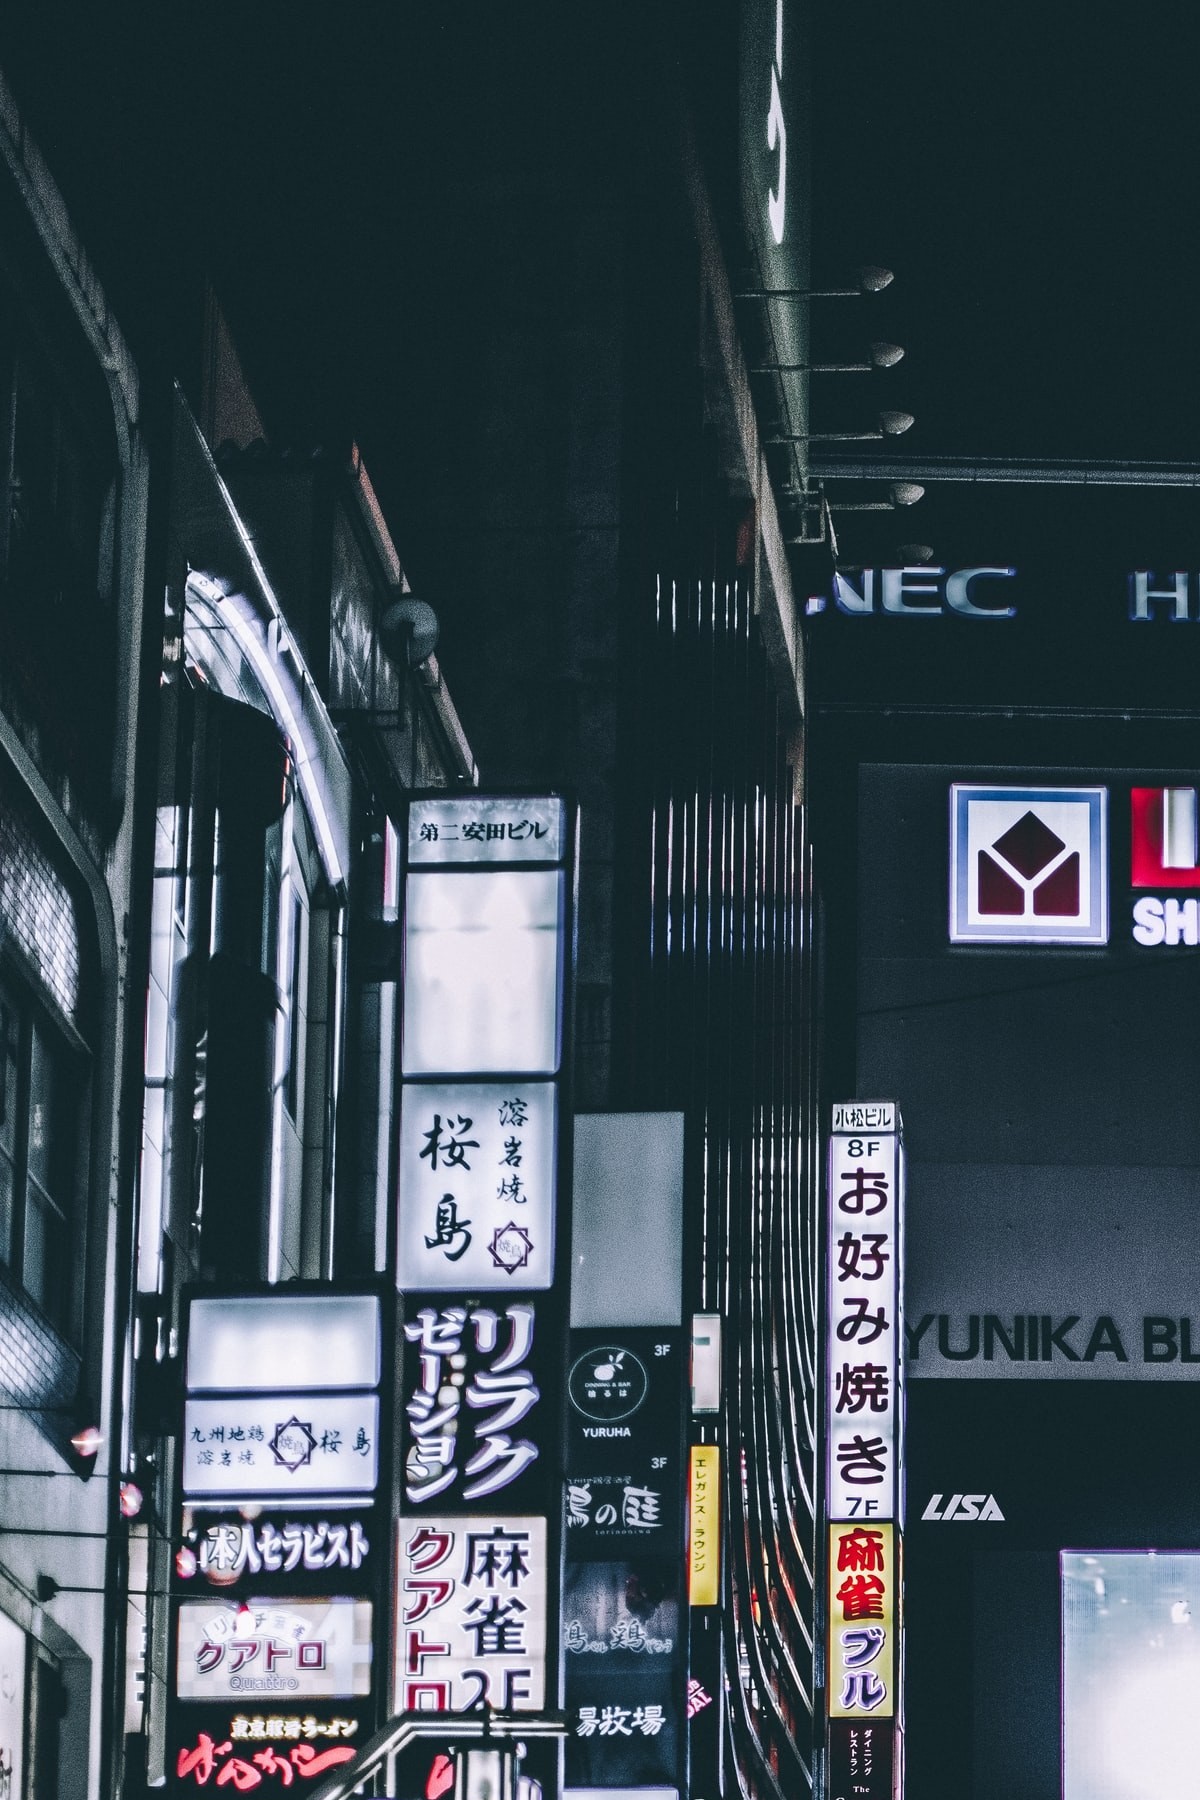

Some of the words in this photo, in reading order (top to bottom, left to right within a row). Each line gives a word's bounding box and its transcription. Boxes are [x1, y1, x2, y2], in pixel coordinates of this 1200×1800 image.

[418, 820, 548, 844] 第二安田ビル
[835, 1108, 892, 1128] 小松ビル
[496, 1098, 530, 1206] 溶岩焼
[847, 1139, 881, 1158] 8F
[419, 1114, 481, 1263] 桜島
[835, 1166, 891, 1486] お好み焼き
[904, 1313, 1129, 1363] YUNIKA
[653, 1344, 672, 1357] 3F
[465, 1308, 540, 1500] リラク
[582, 1427, 632, 1439] YURUHA
[650, 1457, 669, 1469] 3F
[845, 1496, 879, 1517] 7F
[462, 1524, 533, 1660] 麻雀
[195, 1639, 327, 1675] クアトロ
[229, 1675, 299, 1692] Quattro
[849, 1730, 859, 1777] レストラン
[863, 1729, 873, 1777] ダイニング
[852, 1785, 870, 1794] The
